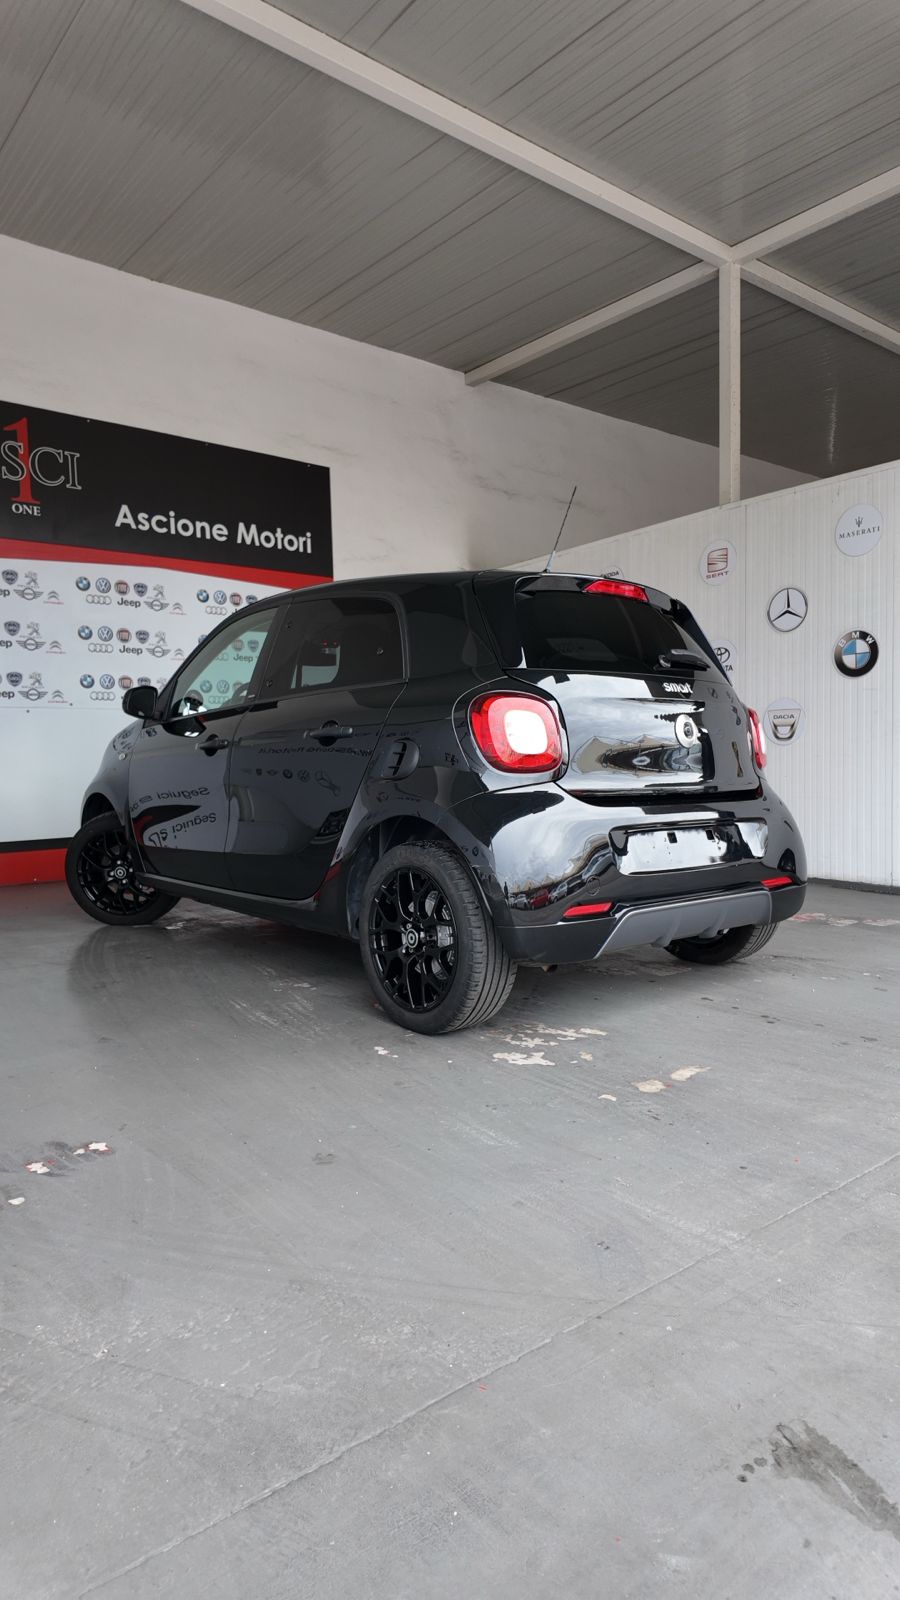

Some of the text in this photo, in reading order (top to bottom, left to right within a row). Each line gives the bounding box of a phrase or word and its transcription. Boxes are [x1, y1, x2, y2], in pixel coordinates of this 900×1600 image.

[11, 503, 42, 516] ONE
[115, 504, 312, 554] Ascione Motori
[839, 525, 880, 538] MASERATI
[117, 598, 141, 608] Jeep
[838, 631, 875, 648] BMW
[119, 645, 143, 655] Jeep
[233, 654, 254, 663] Jeep
[663, 682, 694, 694] smart
